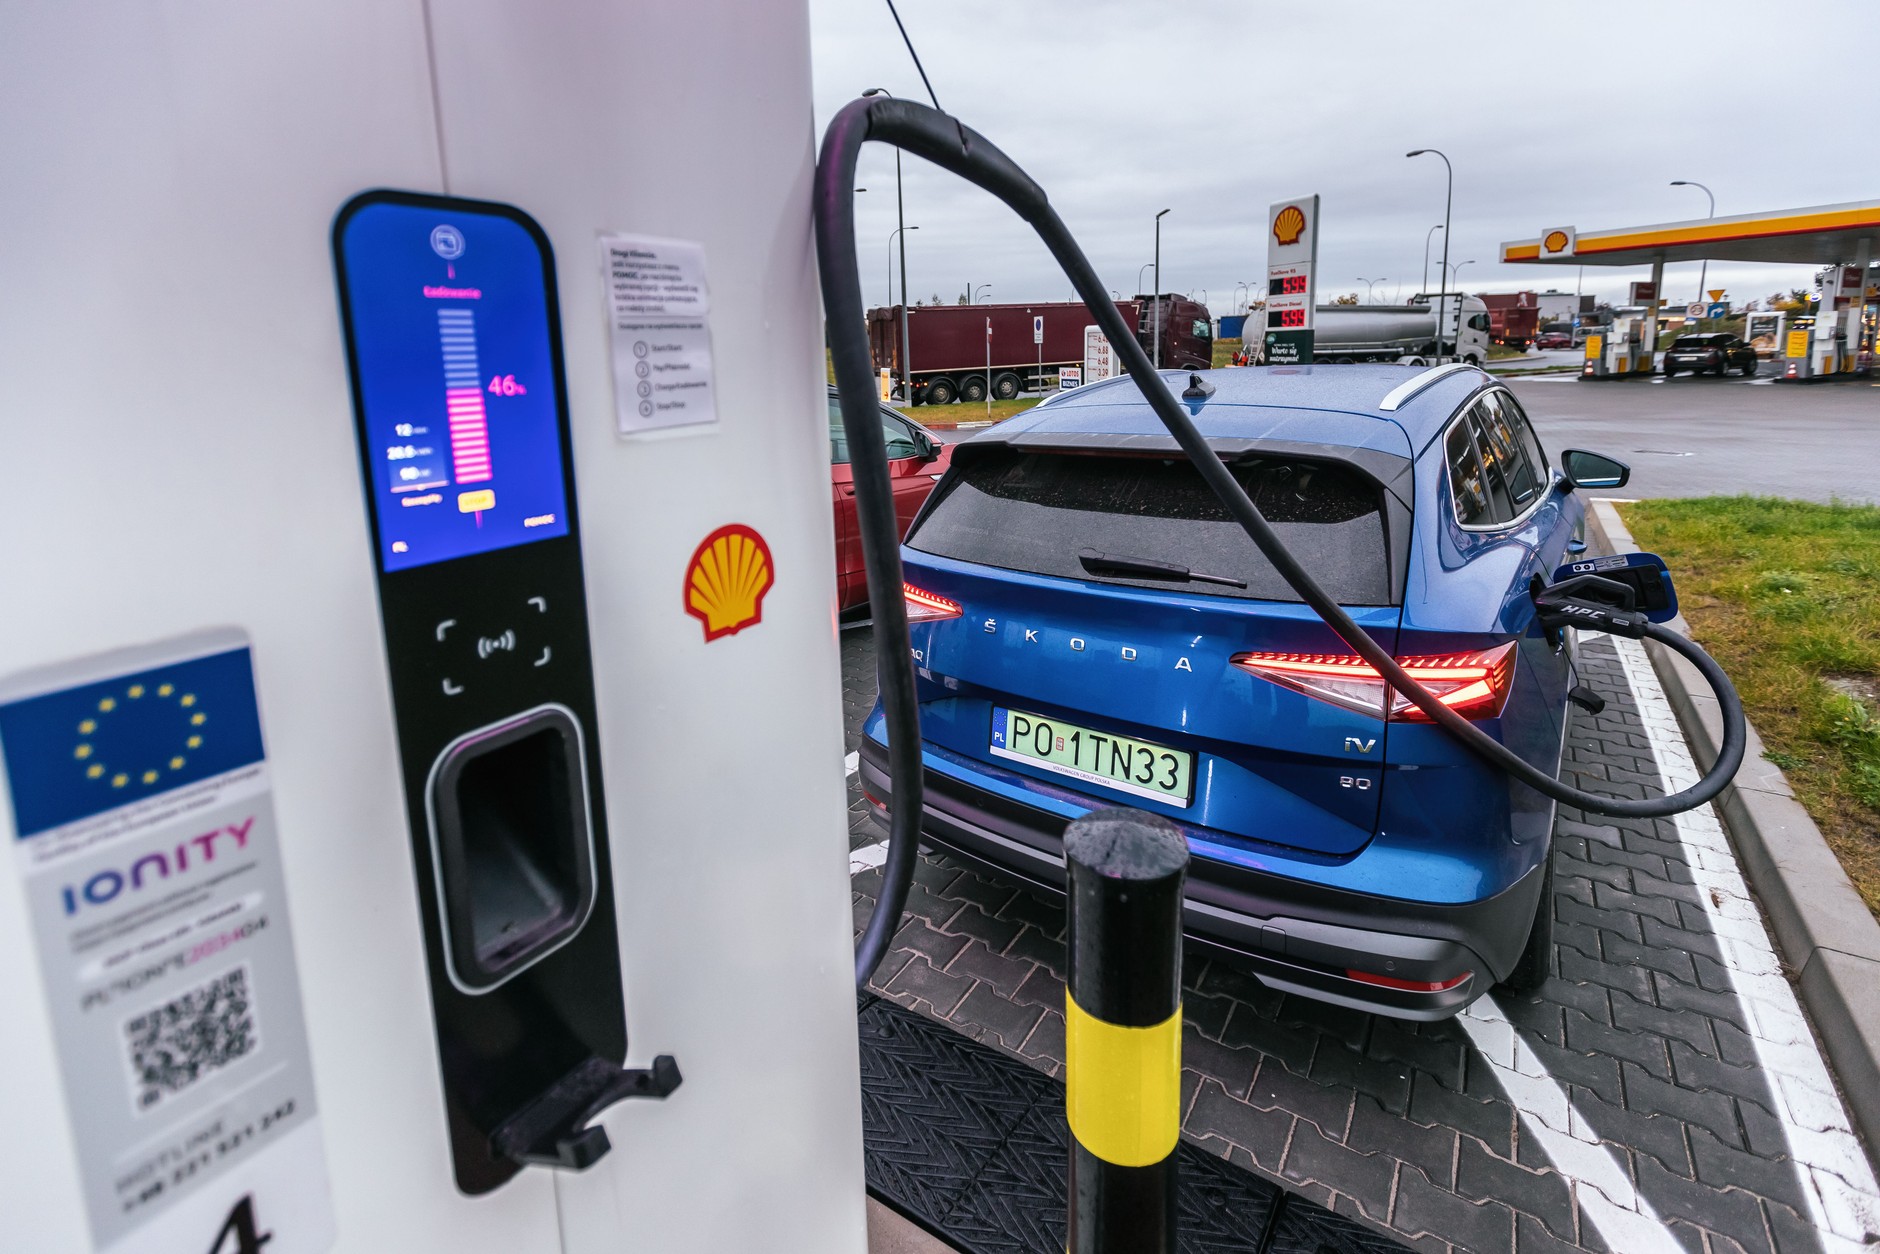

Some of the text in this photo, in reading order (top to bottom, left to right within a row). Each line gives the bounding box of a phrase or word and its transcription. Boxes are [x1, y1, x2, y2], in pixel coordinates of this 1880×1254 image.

[1561, 605, 1606, 619] HPC
[984, 618, 1193, 672] ŠKODA
[994, 731, 1005, 743] PL
[1053, 765, 1111, 785] VOLKSWAGEN GROUP POLSKA
[1340, 776, 1371, 790] 80
[62, 815, 255, 915] IONITY
